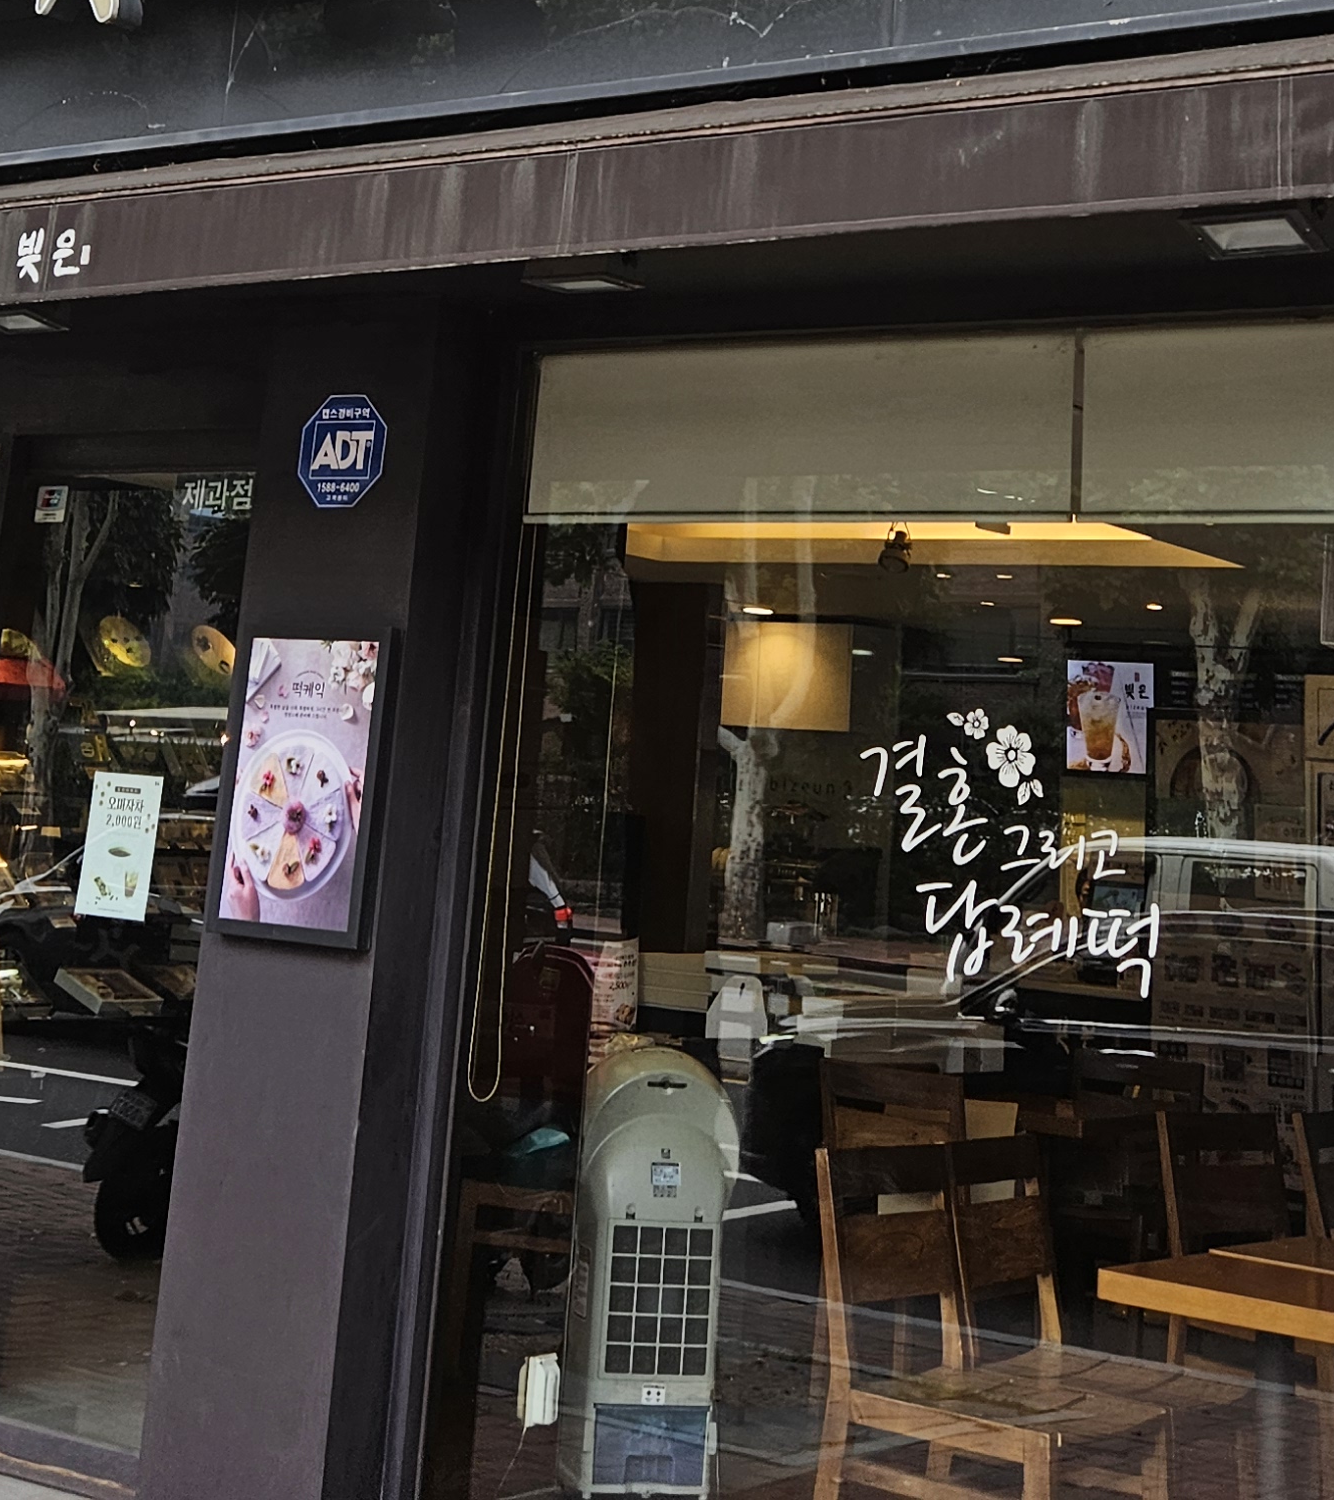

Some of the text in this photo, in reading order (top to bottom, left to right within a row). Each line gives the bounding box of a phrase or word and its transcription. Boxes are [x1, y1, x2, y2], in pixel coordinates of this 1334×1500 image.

[322, 408, 370, 419] 캡스경비구역
[311, 430, 374, 470] ADT
[182, 478, 254, 513] 제과점
[317, 482, 360, 493] 1588-6400
[292, 681, 326, 698] 떡케익
[107, 797, 144, 814] 오미자차
[860, 734, 1126, 880] 결혼 그리고
[105, 814, 142, 830] 2,000원
[916, 880, 1160, 998] 답례떡
